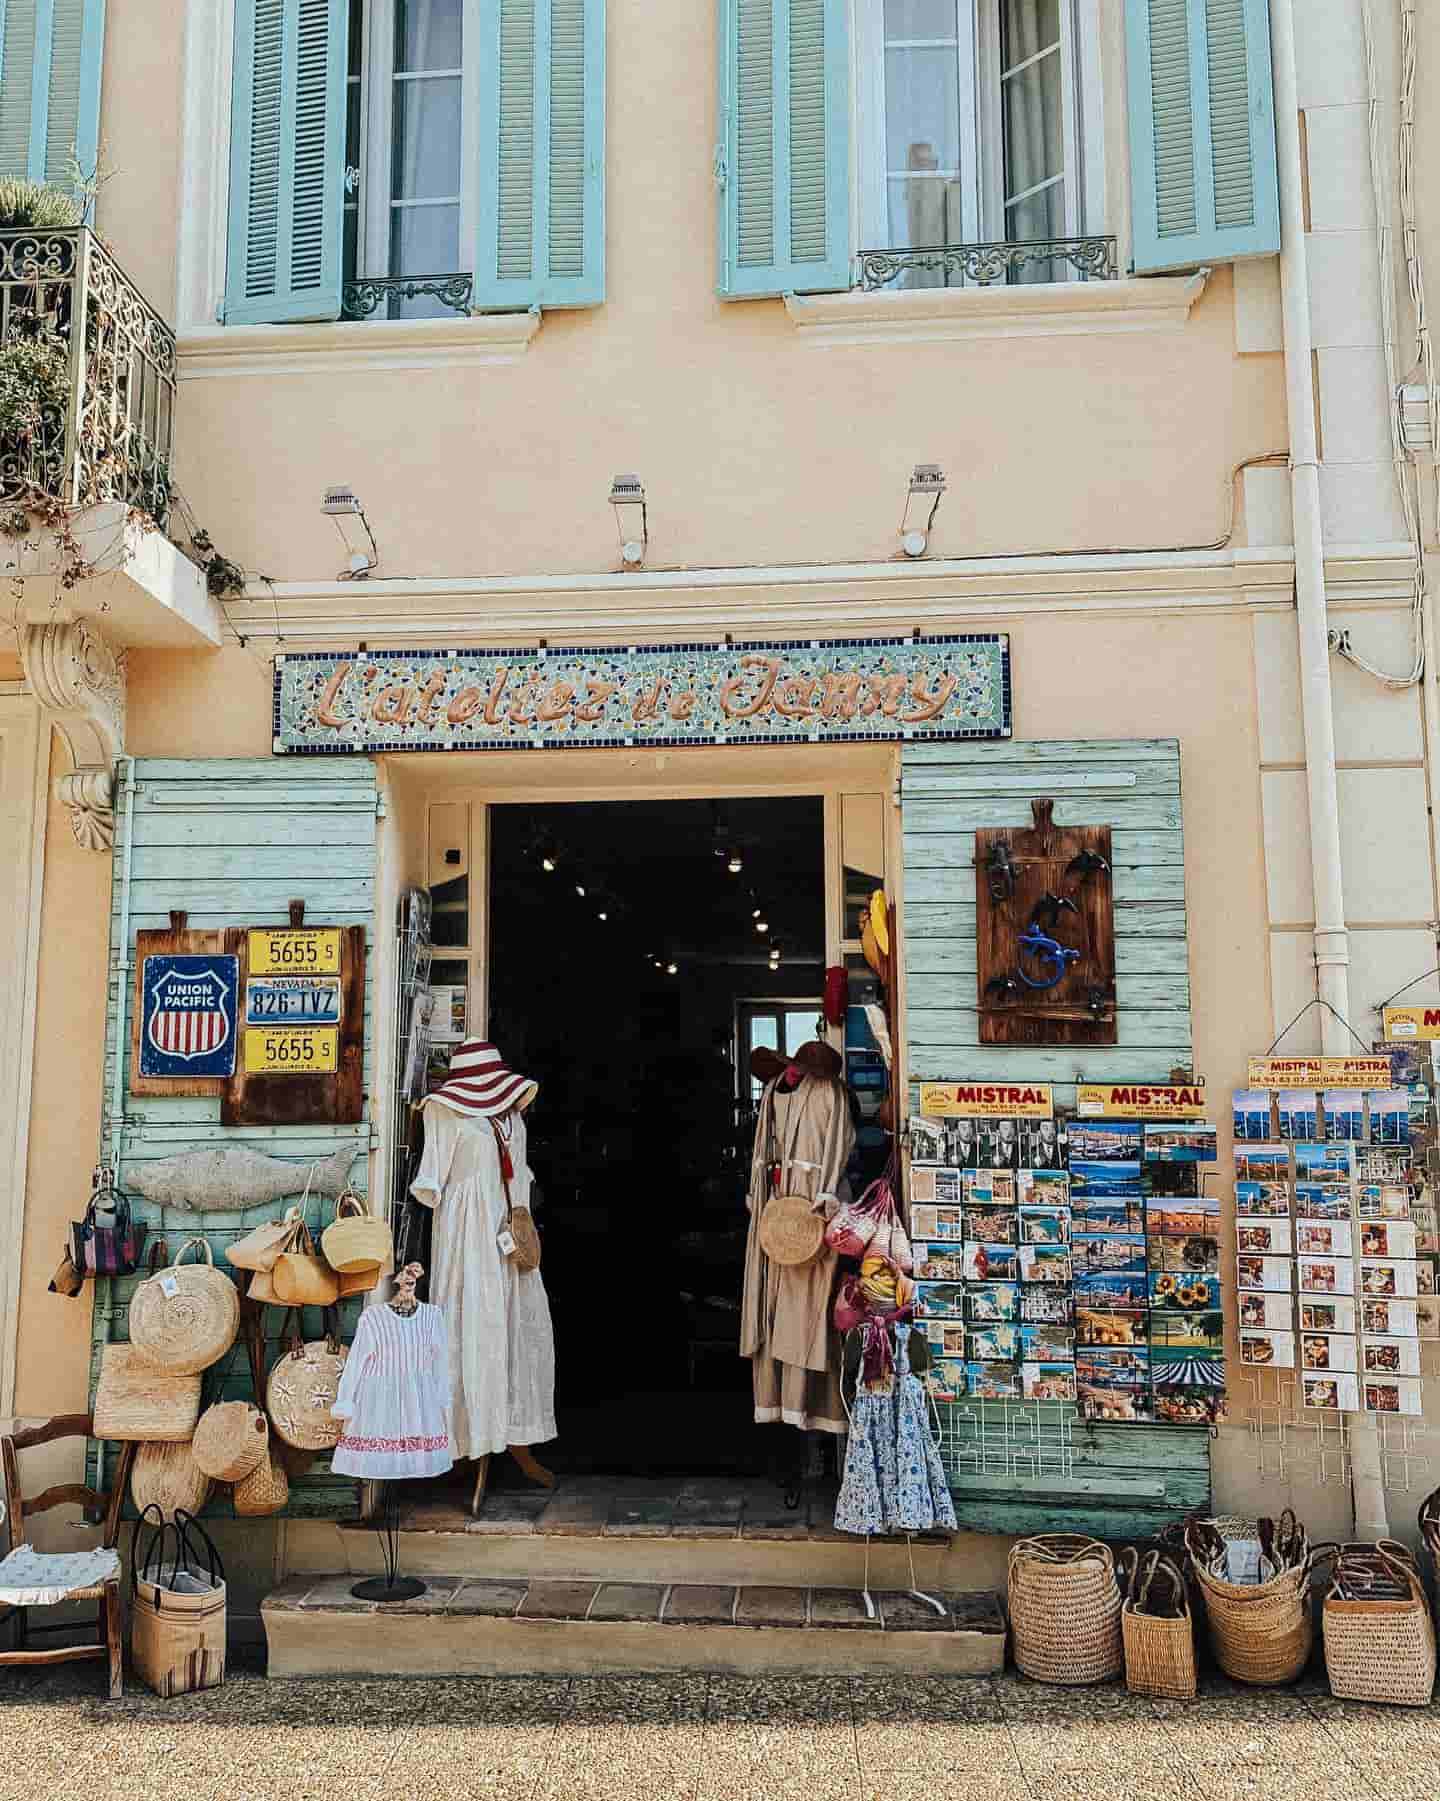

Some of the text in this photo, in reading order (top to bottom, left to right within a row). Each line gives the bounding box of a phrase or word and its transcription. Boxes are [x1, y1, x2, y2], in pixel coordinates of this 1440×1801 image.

[631, 676, 697, 721] de
[269, 941, 317, 963] 5655
[167, 984, 213, 996] UNION
[164, 996, 216, 1007] PACIFIC
[265, 1038, 314, 1061] 5655
[1270, 1061, 1321, 1072] MISTRAL
[1343, 1061, 1392, 1072] MISTRA
[956, 1087, 1047, 1104] MISTRAL
[1110, 1088, 1205, 1106] MISTRAL
